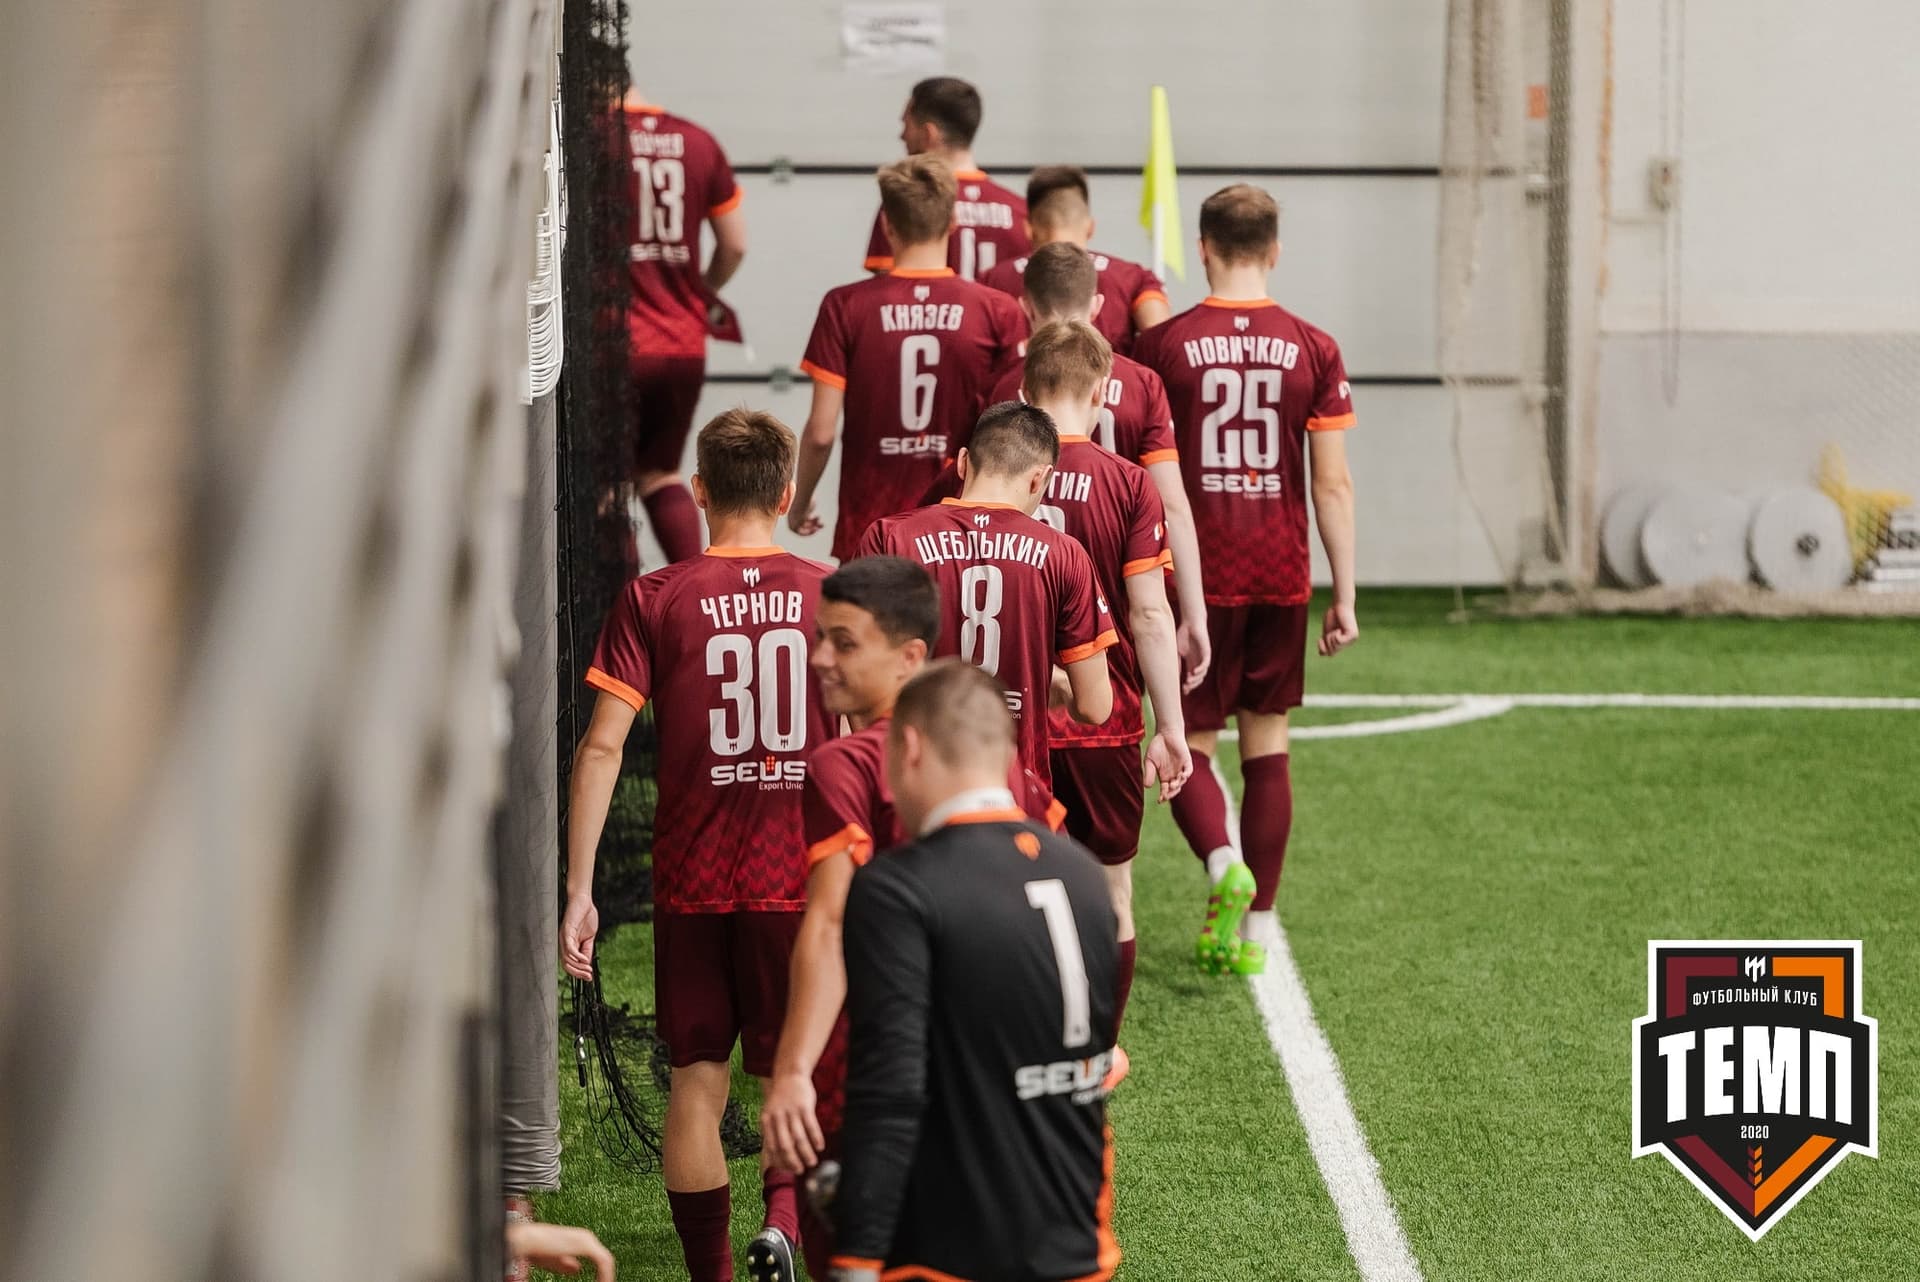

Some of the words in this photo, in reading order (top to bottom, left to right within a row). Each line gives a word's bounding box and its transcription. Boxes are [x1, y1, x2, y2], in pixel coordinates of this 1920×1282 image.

[632, 156, 685, 241] 13
[880, 304, 964, 332] КНЯЗЕВ
[1184, 336, 1299, 370] НОВИЧКОВ
[901, 334, 940, 432] 6
[1201, 368, 1282, 470] 25
[880, 434, 948, 455] SEUS
[1201, 473, 1281, 493] SEUS
[915, 530, 1049, 570] ЩЕБЛЫКИН
[700, 591, 803, 629] ЧЕРНОВ
[961, 565, 1003, 678] 8
[706, 628, 807, 756] 30
[711, 760, 808, 786] SEUS
[759, 782, 783, 791] Export
[785, 781, 804, 790] Unio
[1024, 879, 1091, 1048] 1
